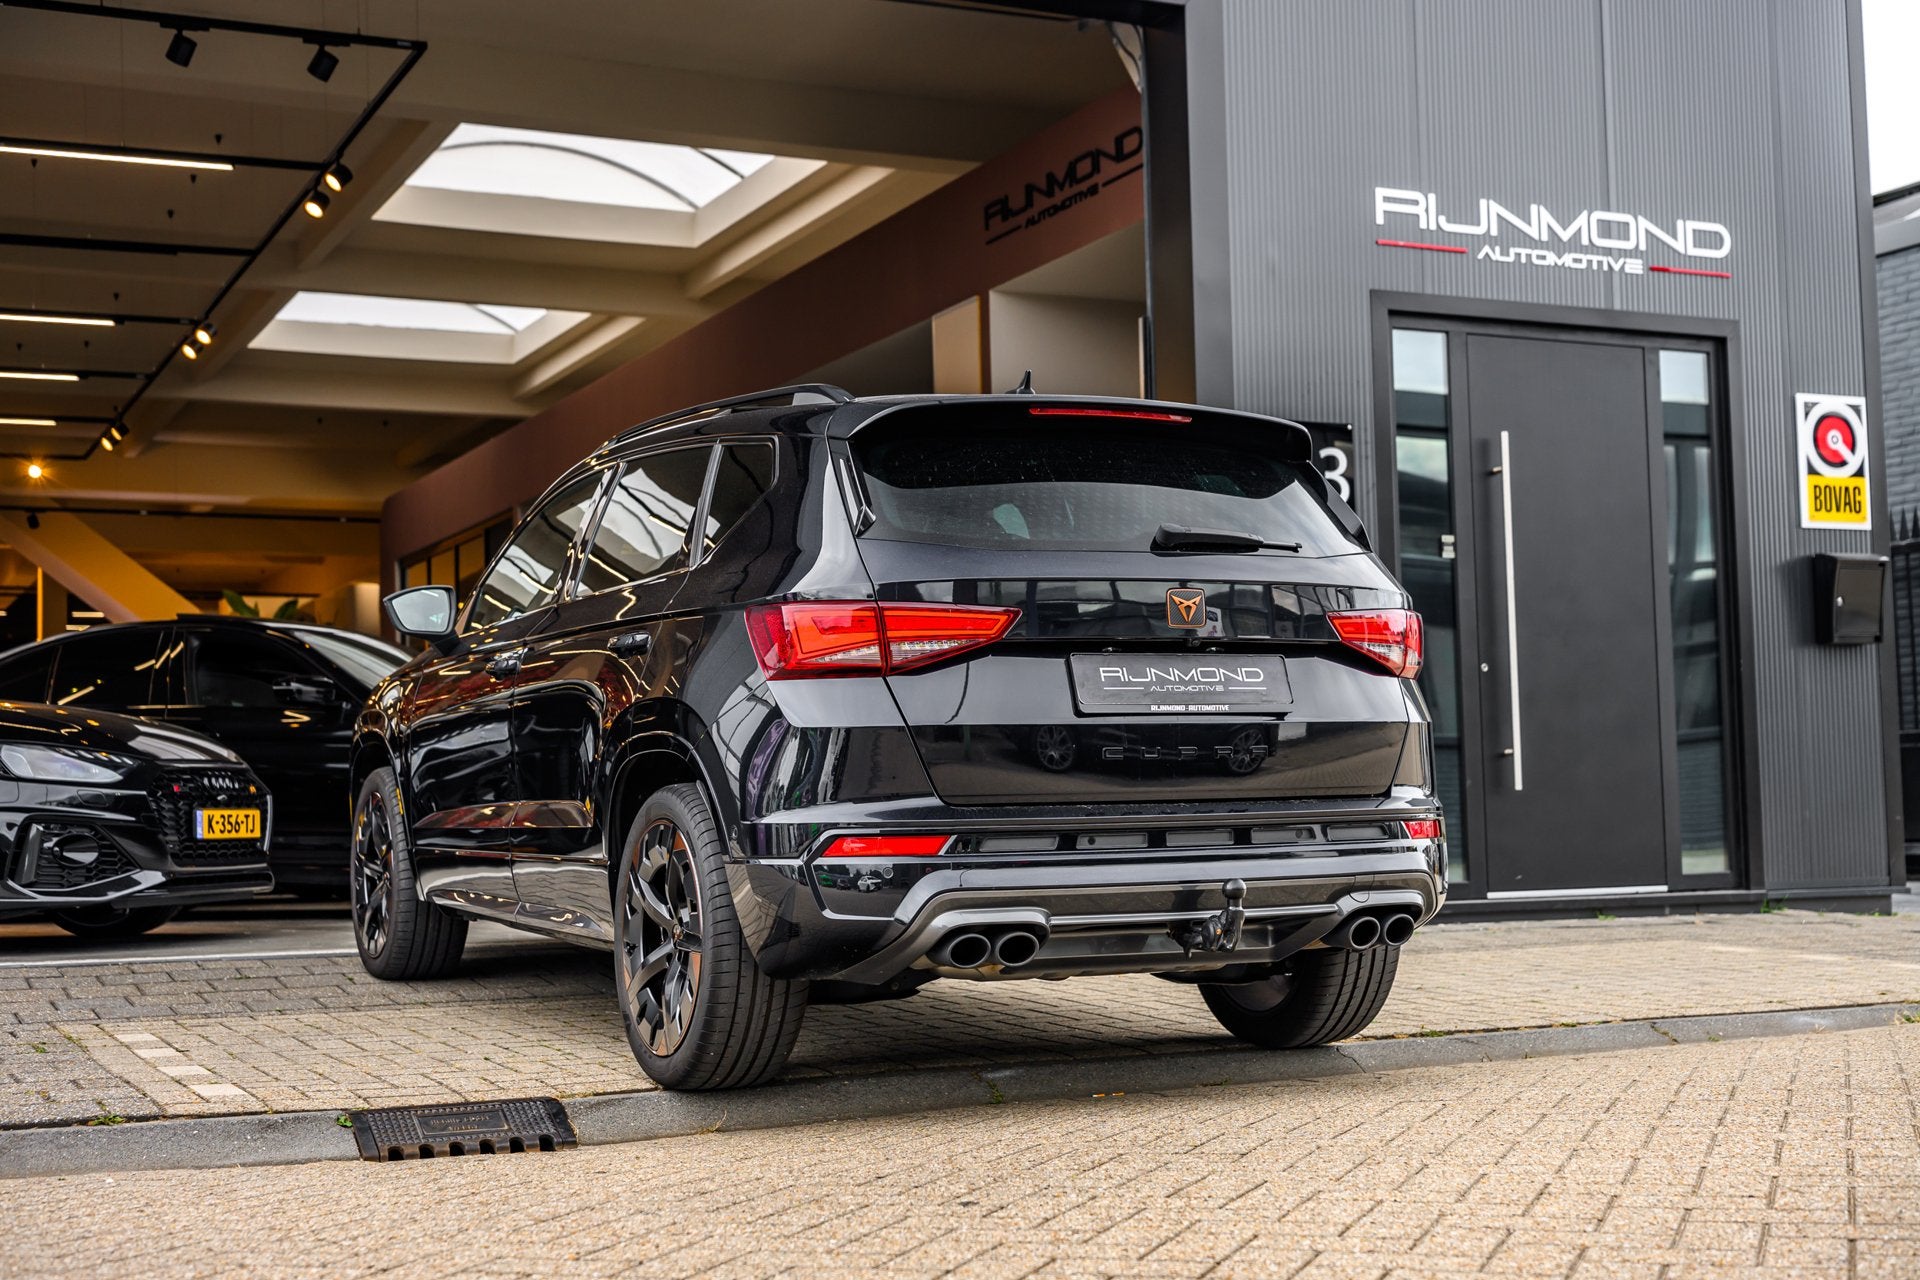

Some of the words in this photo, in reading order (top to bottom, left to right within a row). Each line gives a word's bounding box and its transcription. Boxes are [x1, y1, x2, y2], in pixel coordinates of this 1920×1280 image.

[984, 126, 1143, 231] RIJNMOND
[1024, 183, 1100, 229] AUTOMOTIVE
[1375, 186, 1732, 259] RIJNMOND
[1477, 244, 1644, 275] AUTOMOTIVE
[1318, 446, 1350, 503] 3
[1813, 484, 1862, 514] BOVAG
[1099, 667, 1264, 682] RIJNMOND
[1102, 745, 1269, 760] CUPRA
[207, 814, 256, 835] K-356-TJ
